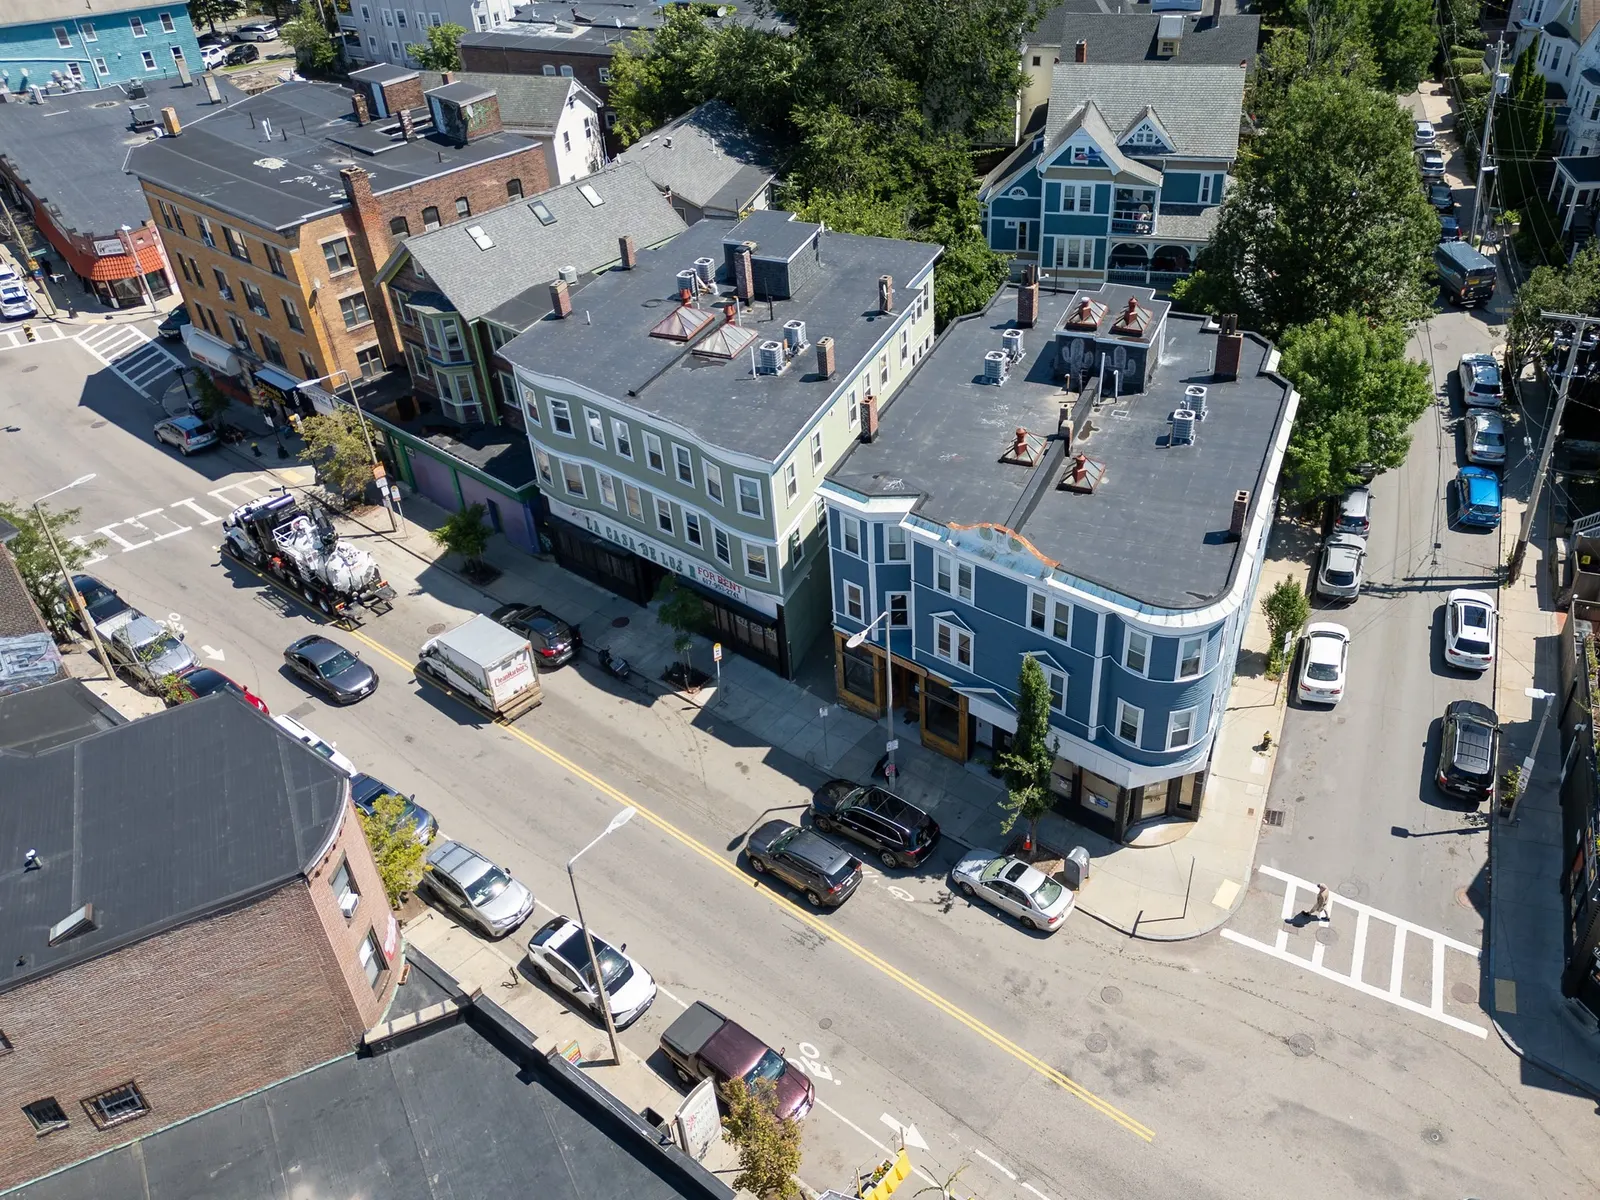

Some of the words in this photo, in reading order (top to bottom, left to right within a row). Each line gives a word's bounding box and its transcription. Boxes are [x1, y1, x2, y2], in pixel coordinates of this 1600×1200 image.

[585, 516, 601, 535] LA
[605, 526, 636, 551] CASA
[638, 542, 657, 562] DE
[660, 552, 683, 572] LOS
[697, 567, 716, 581] FOR
[717, 575, 743, 593] RENT
